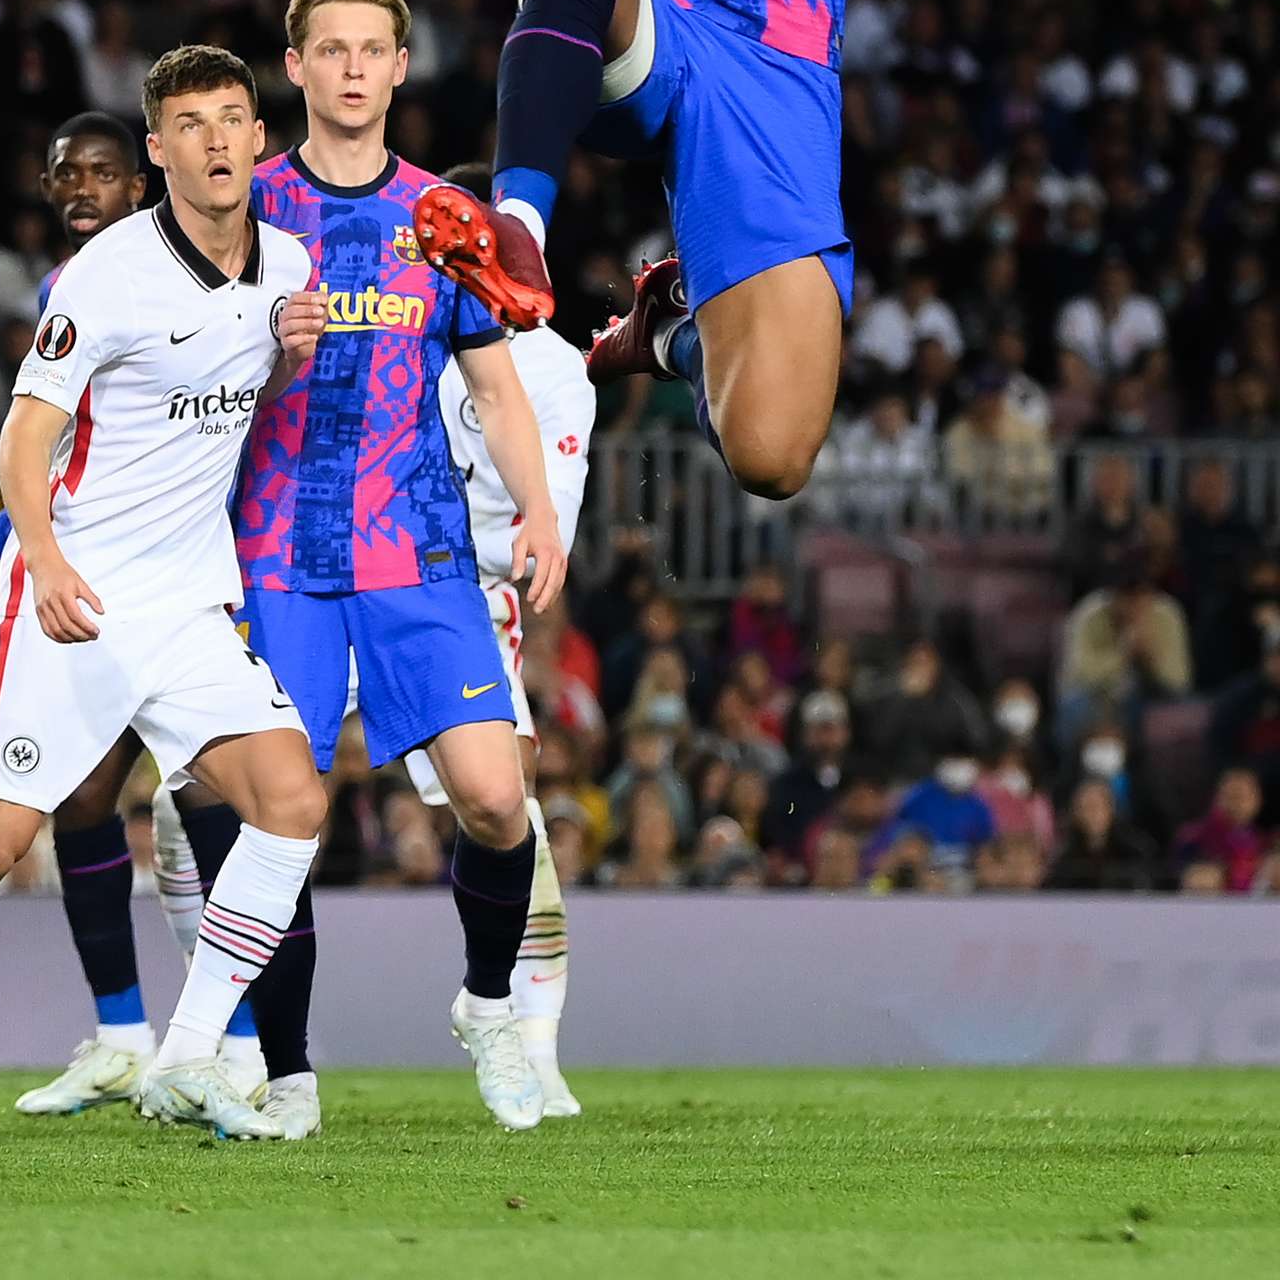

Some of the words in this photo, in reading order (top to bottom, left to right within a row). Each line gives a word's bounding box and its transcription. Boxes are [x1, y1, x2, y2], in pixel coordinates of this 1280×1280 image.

[319, 282, 425, 329] kuten
[168, 384, 256, 420] indee
[197, 420, 230, 435] Jobs
